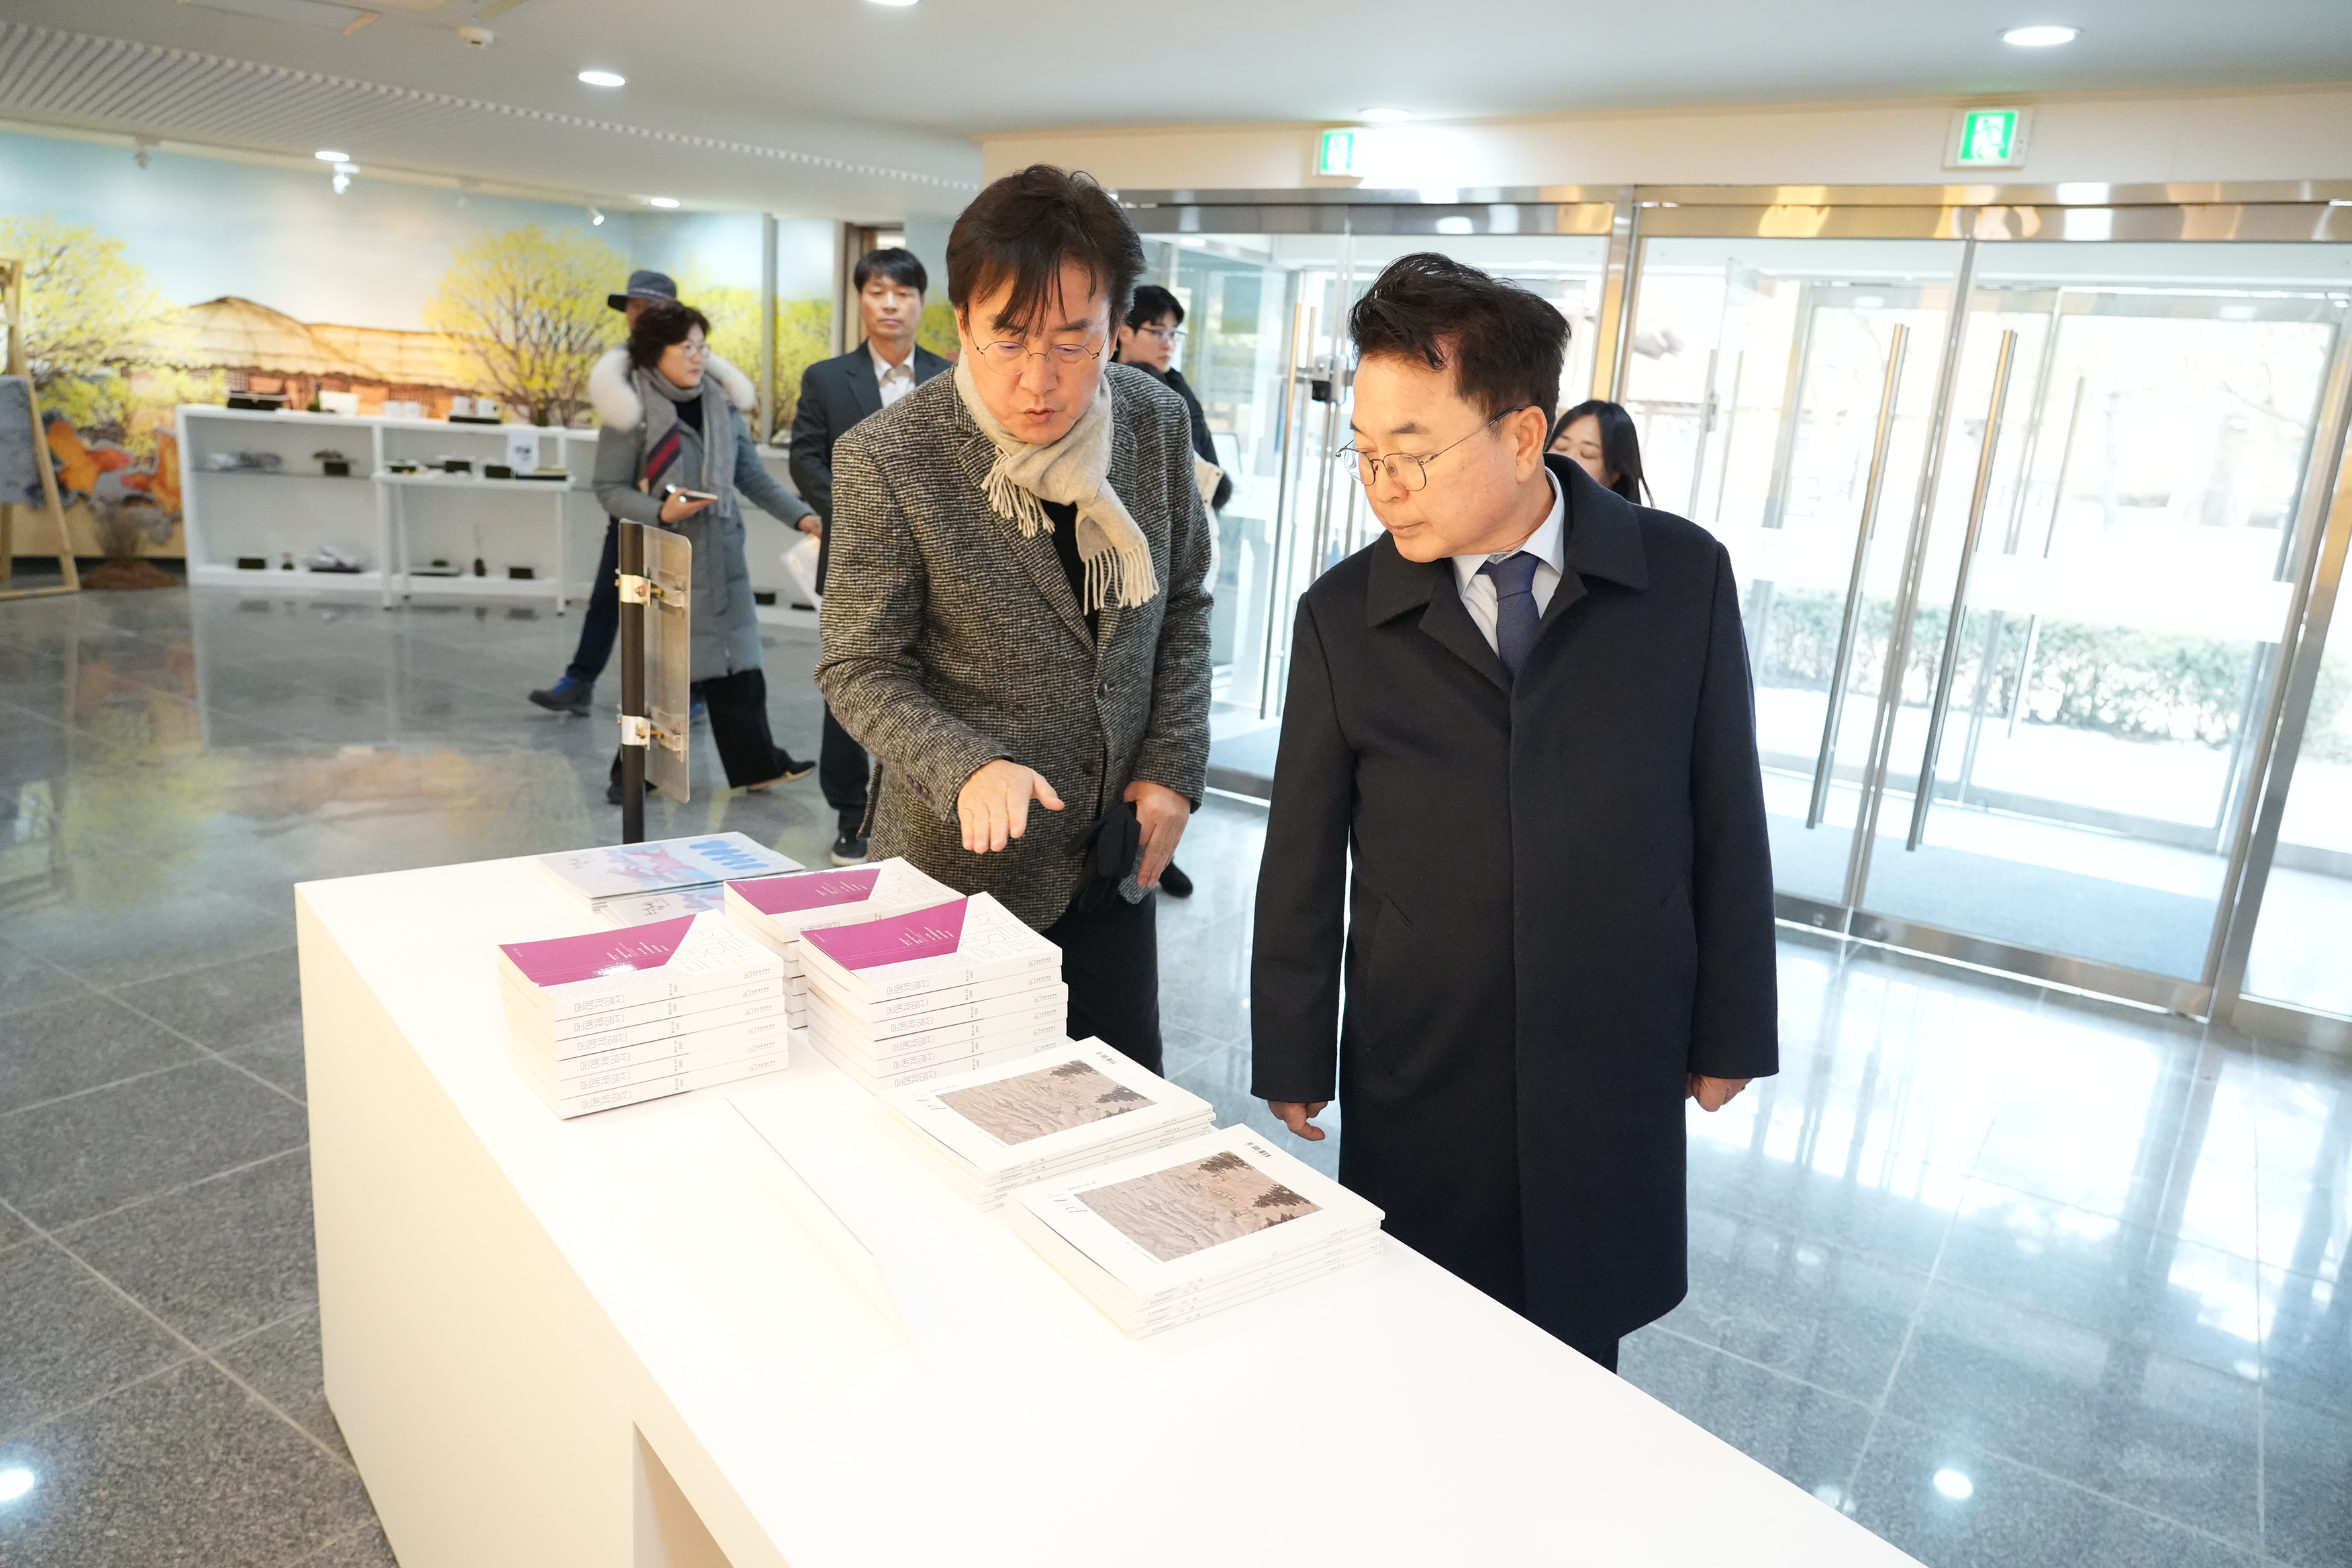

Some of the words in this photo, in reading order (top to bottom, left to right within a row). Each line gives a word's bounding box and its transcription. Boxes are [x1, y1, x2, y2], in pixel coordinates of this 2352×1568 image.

[575, 994, 625, 1012] 문예제일선
[574, 1014, 624, 1032] 문예제일선
[577, 1033, 628, 1051] 문예제일선
[580, 1052, 630, 1071] 문예제일선
[580, 1071, 630, 1090] 문예제일선
[581, 1090, 632, 1110] 문예제일선
